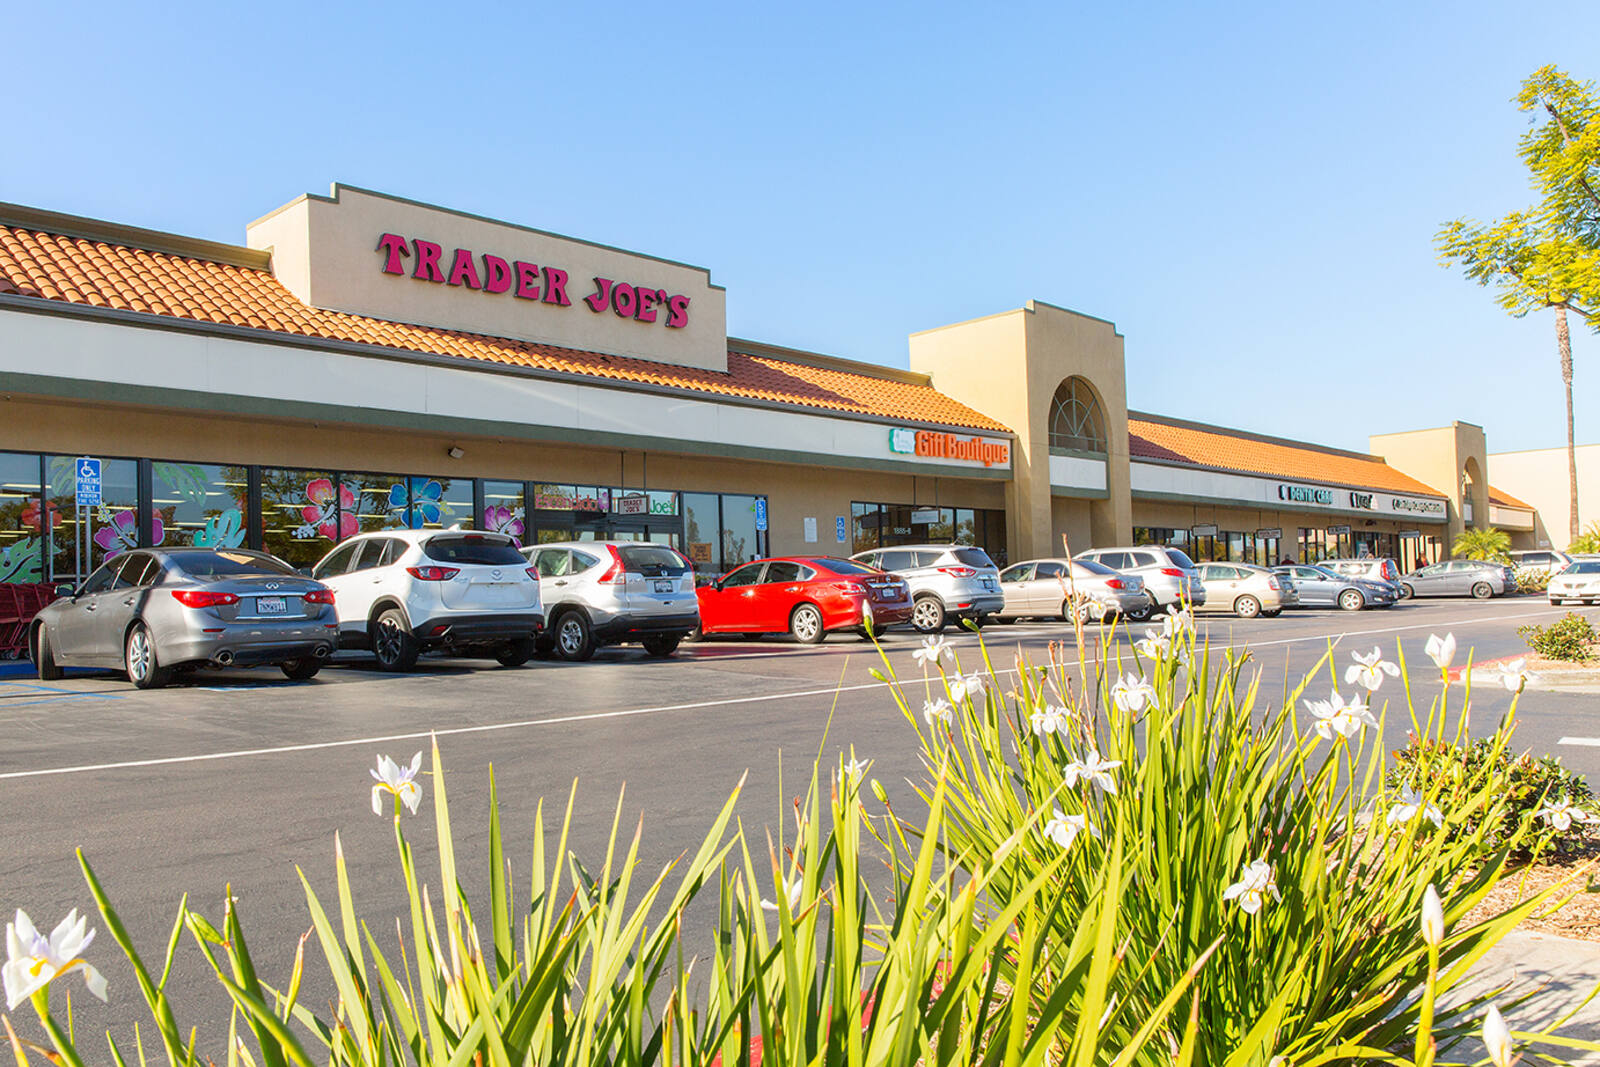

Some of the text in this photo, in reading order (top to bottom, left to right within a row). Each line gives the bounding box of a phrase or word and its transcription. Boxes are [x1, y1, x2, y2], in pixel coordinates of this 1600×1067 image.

[376, 233, 690, 328] TRADER JOE'S
[915, 430, 1008, 467] Gift Boutique
[535, 494, 598, 511] Escondido
[650, 499, 675, 515] Joe's
